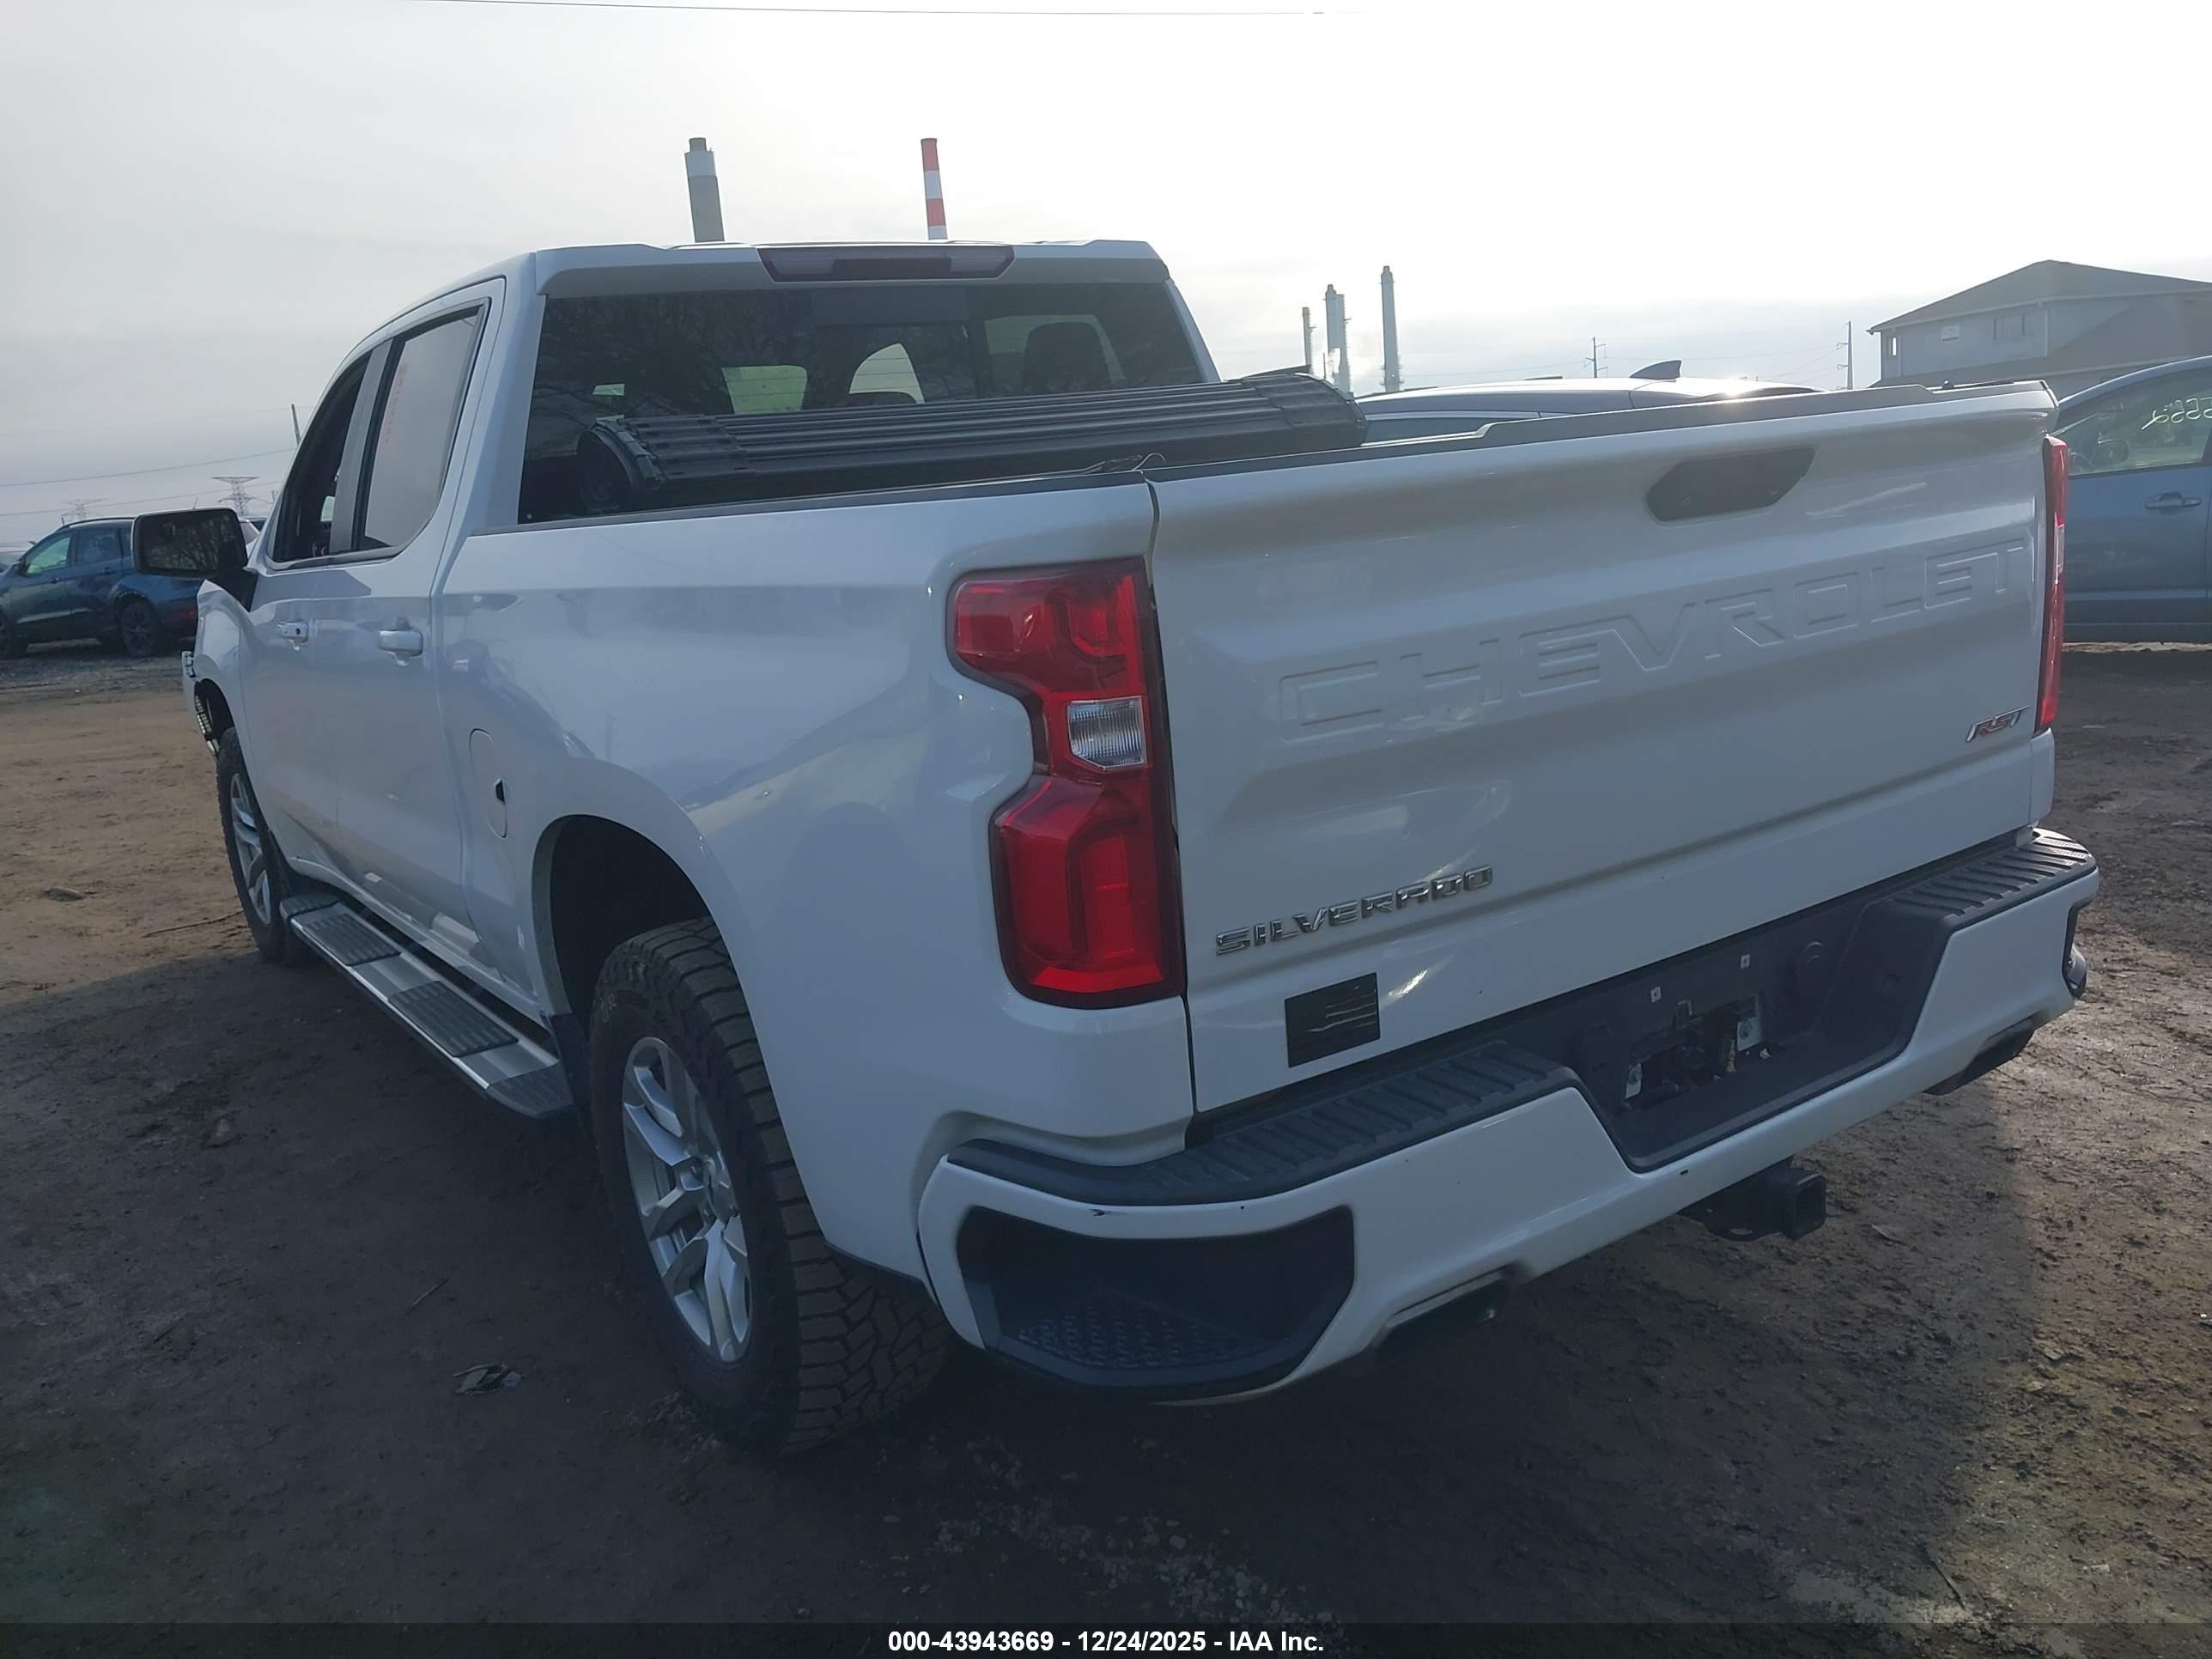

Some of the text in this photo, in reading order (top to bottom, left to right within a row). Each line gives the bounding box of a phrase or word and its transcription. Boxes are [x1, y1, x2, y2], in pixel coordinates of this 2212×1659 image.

[1279, 538, 2028, 741] CHEVROLET
[1966, 705, 2032, 742] RST
[1216, 865, 1493, 955] SILVERADO
